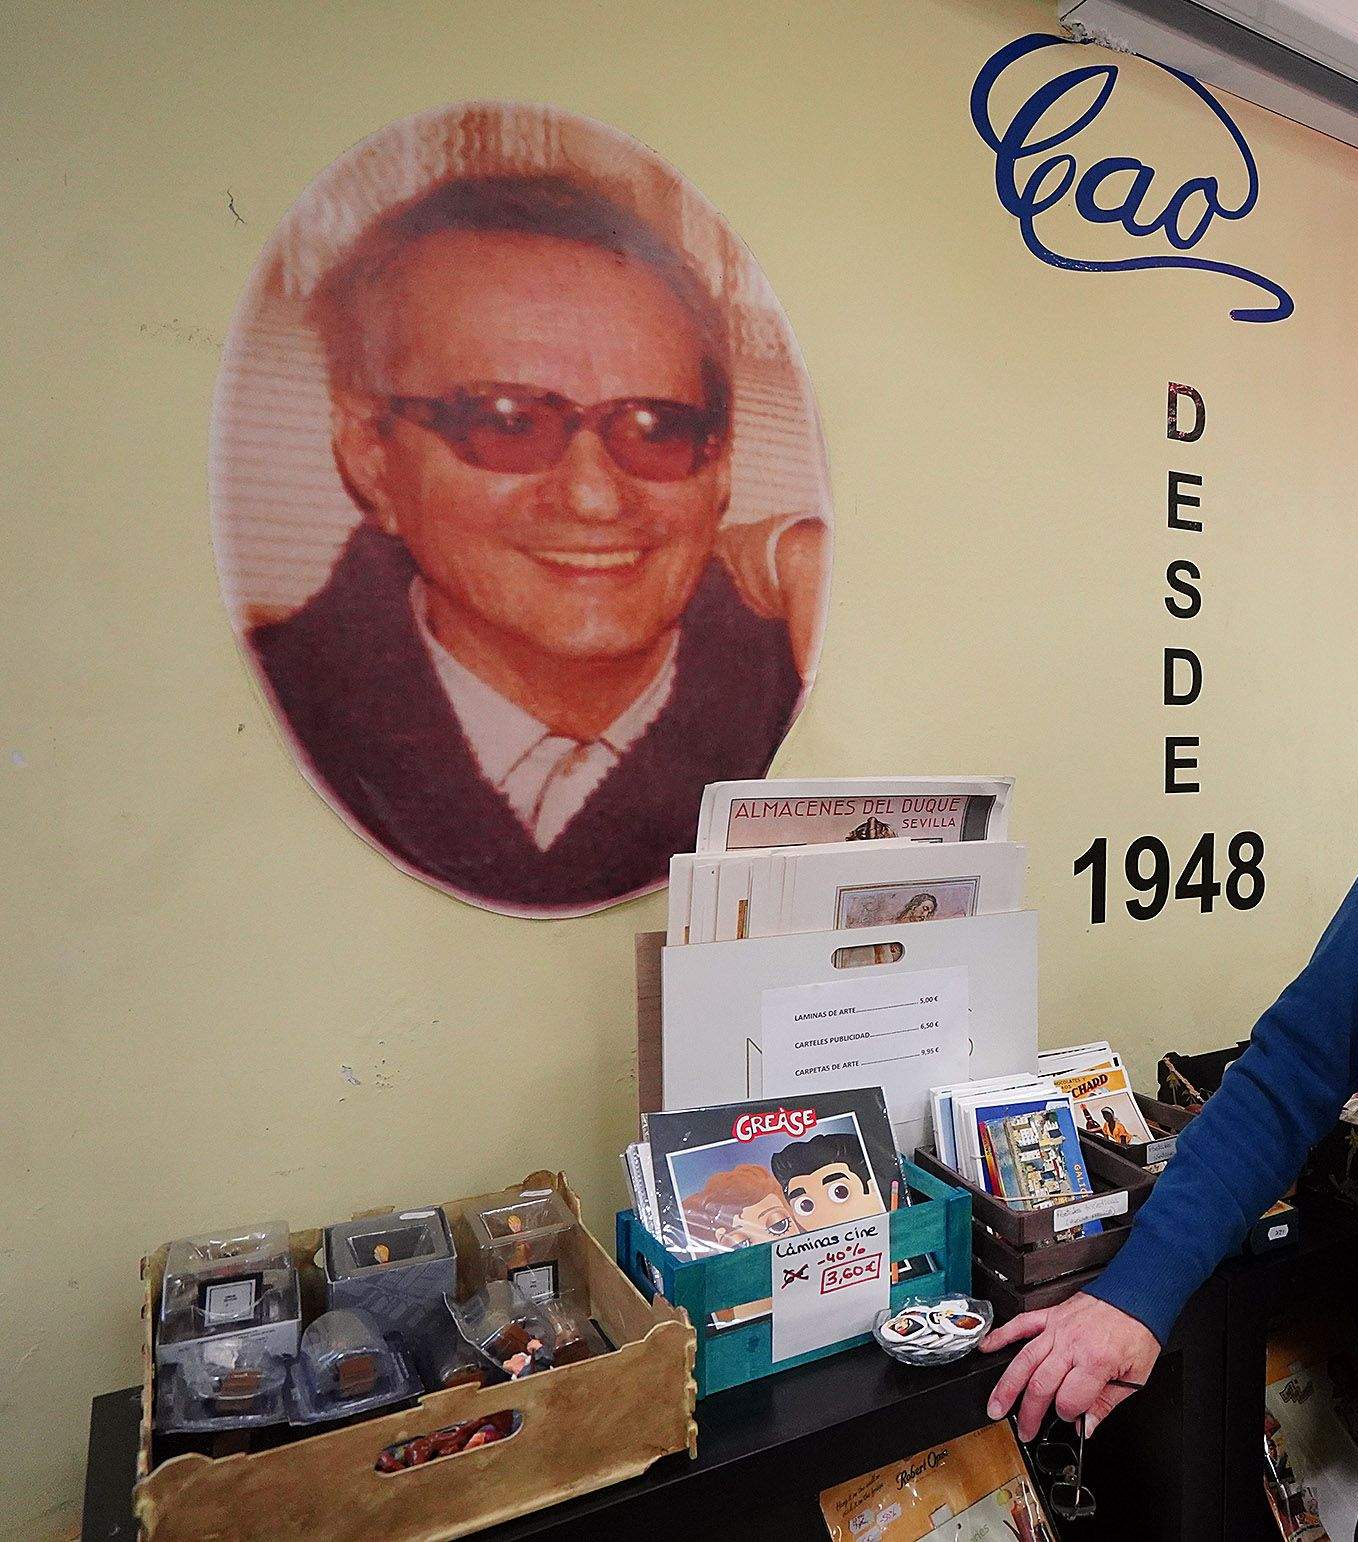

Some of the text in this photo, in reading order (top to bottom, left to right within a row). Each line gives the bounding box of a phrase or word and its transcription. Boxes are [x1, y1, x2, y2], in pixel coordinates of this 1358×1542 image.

[970, 33, 1294, 322] Cao
[1164, 381, 1206, 794] DESDE
[735, 797, 960, 819] ALMACENES DEL DUQUE
[902, 817, 956, 829] SEVILLA
[1073, 830, 1266, 925] 1948
[794, 1010, 827, 1022] LAMINAS
[828, 1009, 837, 1018] DE
[794, 1038, 829, 1050] CARTELES
[920, 1022, 934, 1031] 6,50
[794, 1065, 830, 1077] CARPETAS
[831, 1063, 841, 1072] DE
[841, 1060, 860, 1069] ARTE
[920, 1047, 935, 1057] 9,95
[1071, 1073, 1108, 1098] CHARD
[844, 1226, 879, 1241] cine
[817, 1242, 866, 1265] -40%
[825, 1261, 877, 1286] 3,60€
[896, 1458, 927, 1490] Robert
